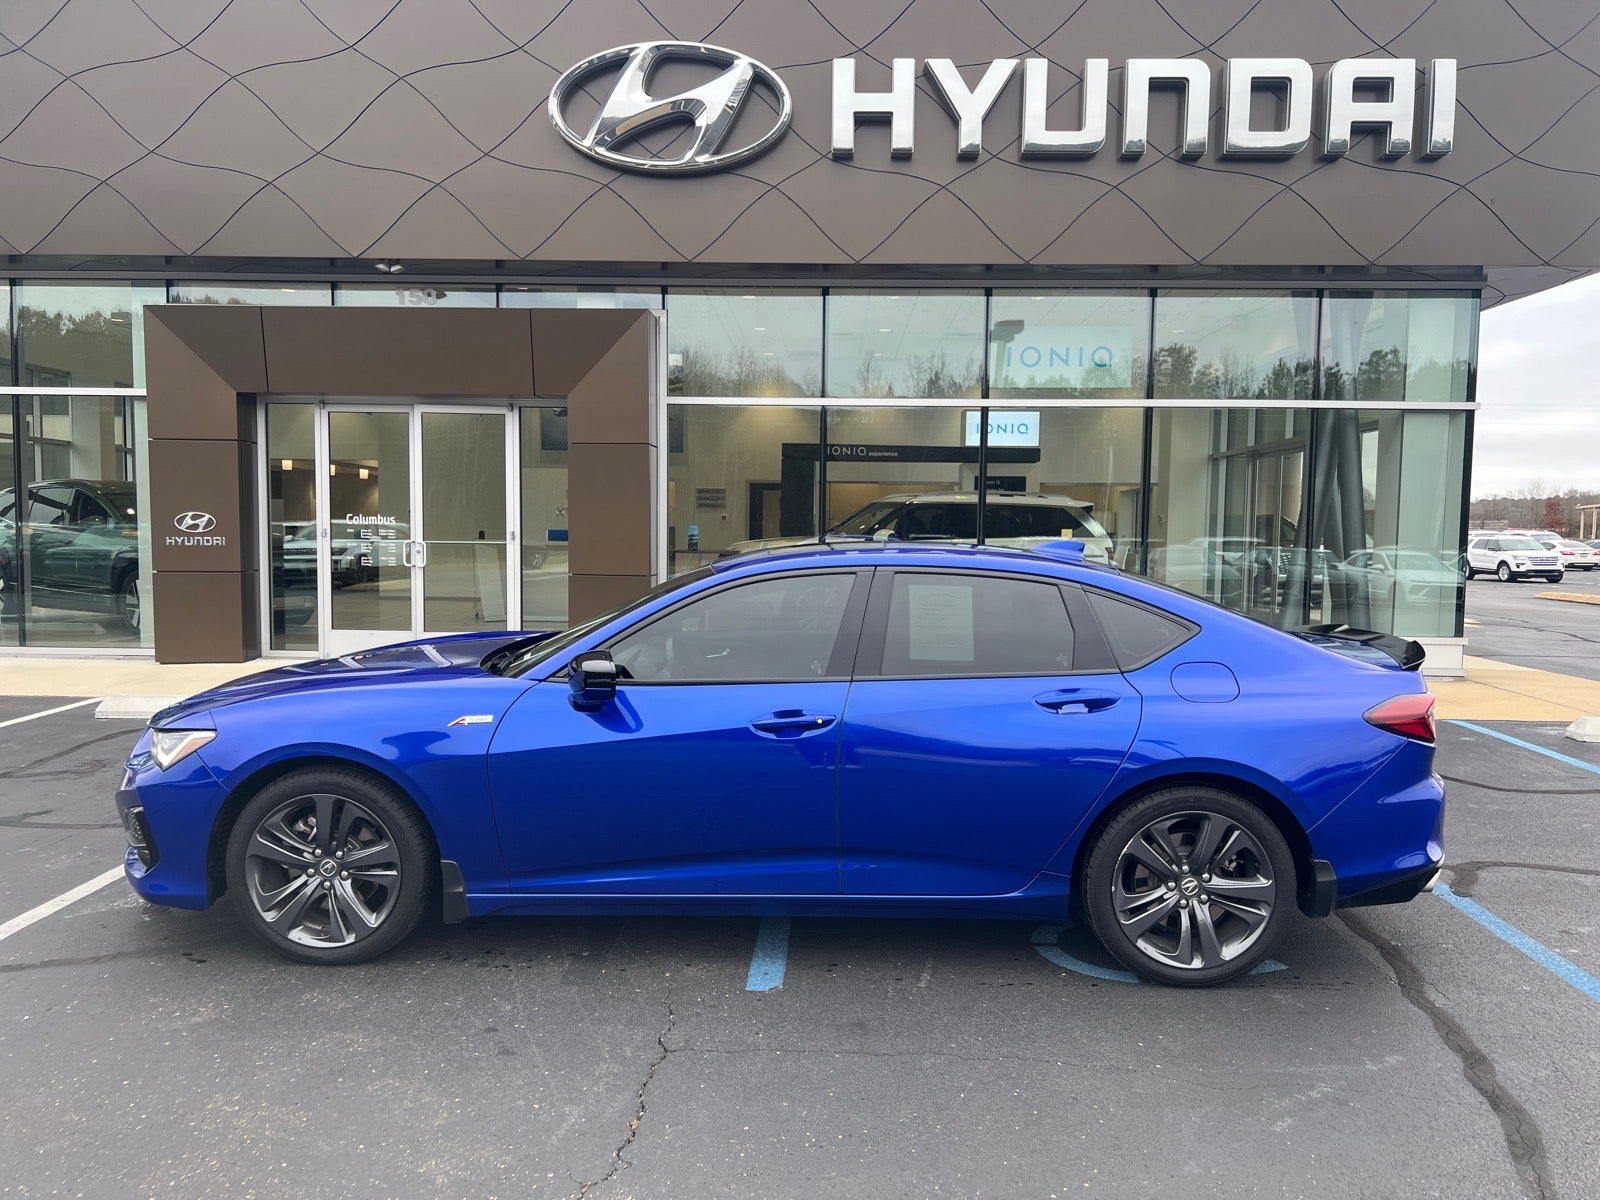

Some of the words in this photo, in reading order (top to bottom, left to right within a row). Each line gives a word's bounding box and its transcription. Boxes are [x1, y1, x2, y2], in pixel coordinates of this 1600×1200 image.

[832, 57, 1457, 158] HYUNDAI
[1006, 345, 1113, 368] IONIQ
[827, 446, 867, 456] IONIQ
[345, 513, 396, 525] Columbus
[165, 536, 226, 546] HYUNDAI
